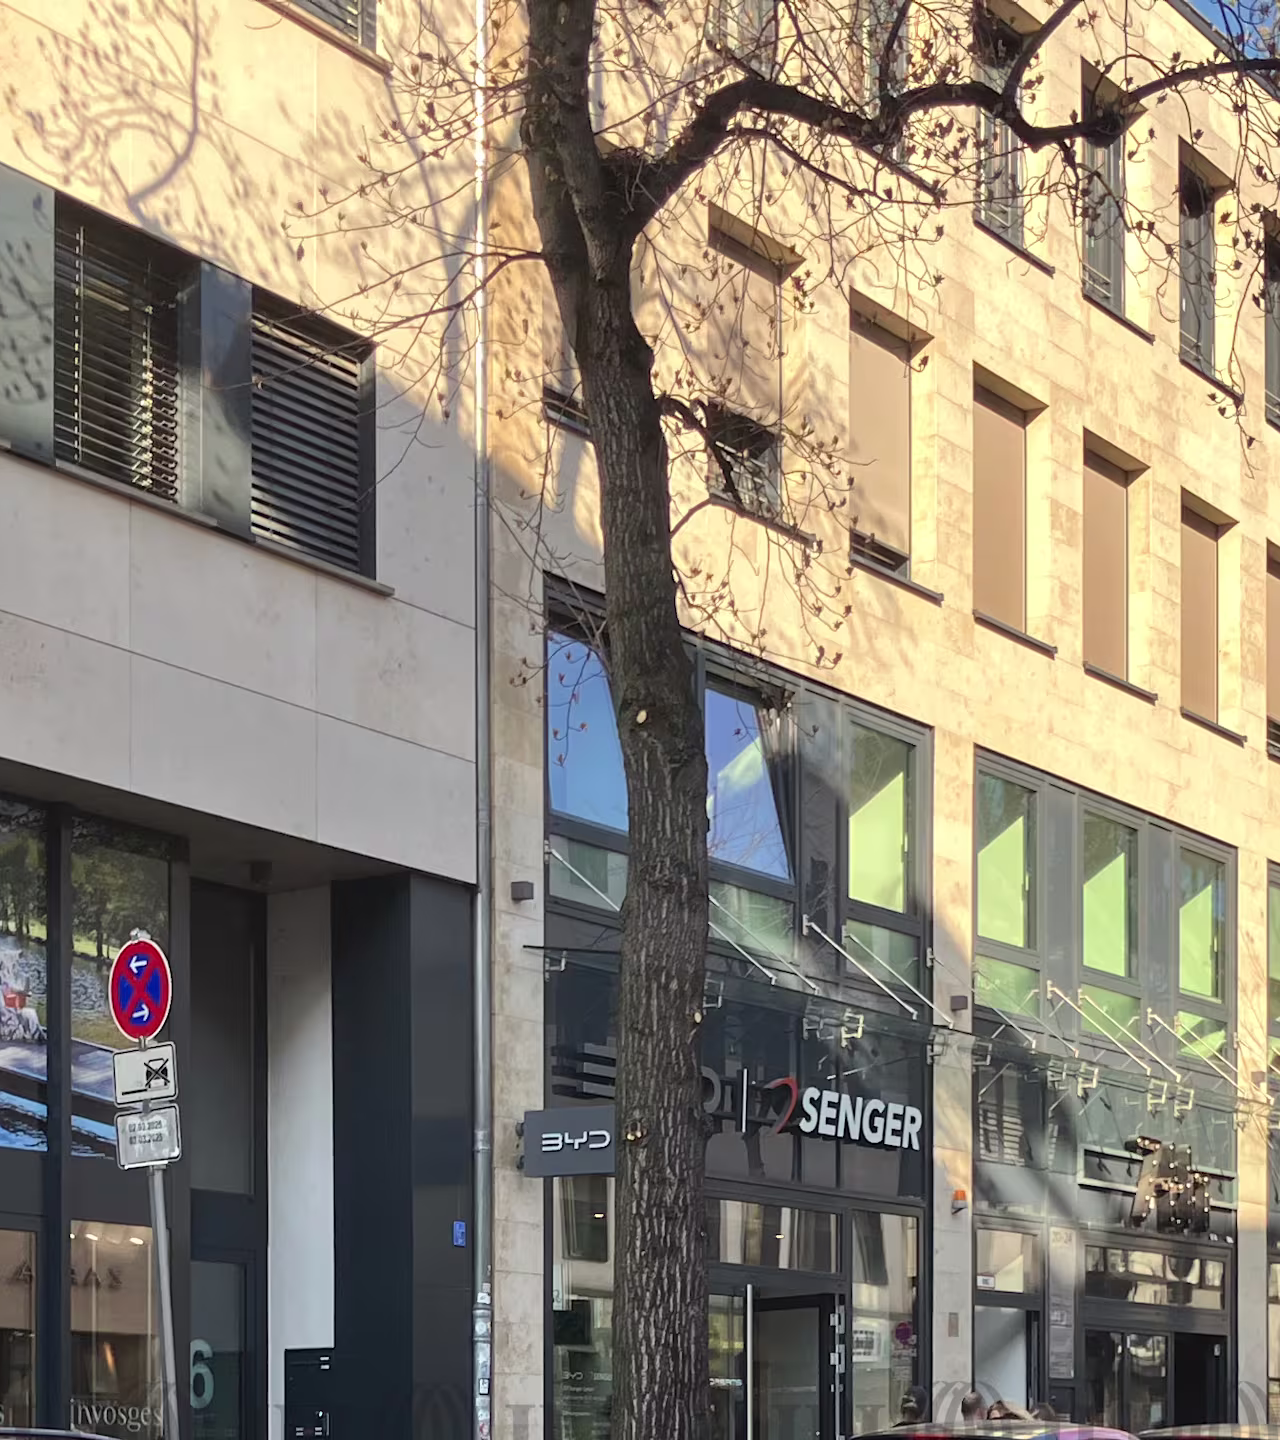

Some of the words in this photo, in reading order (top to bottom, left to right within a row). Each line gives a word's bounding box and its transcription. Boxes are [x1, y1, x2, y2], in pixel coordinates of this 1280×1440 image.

[798, 1086, 922, 1151] SENGER
[541, 1130, 611, 1153] BYD
[70, 1397, 163, 1432] invosges
